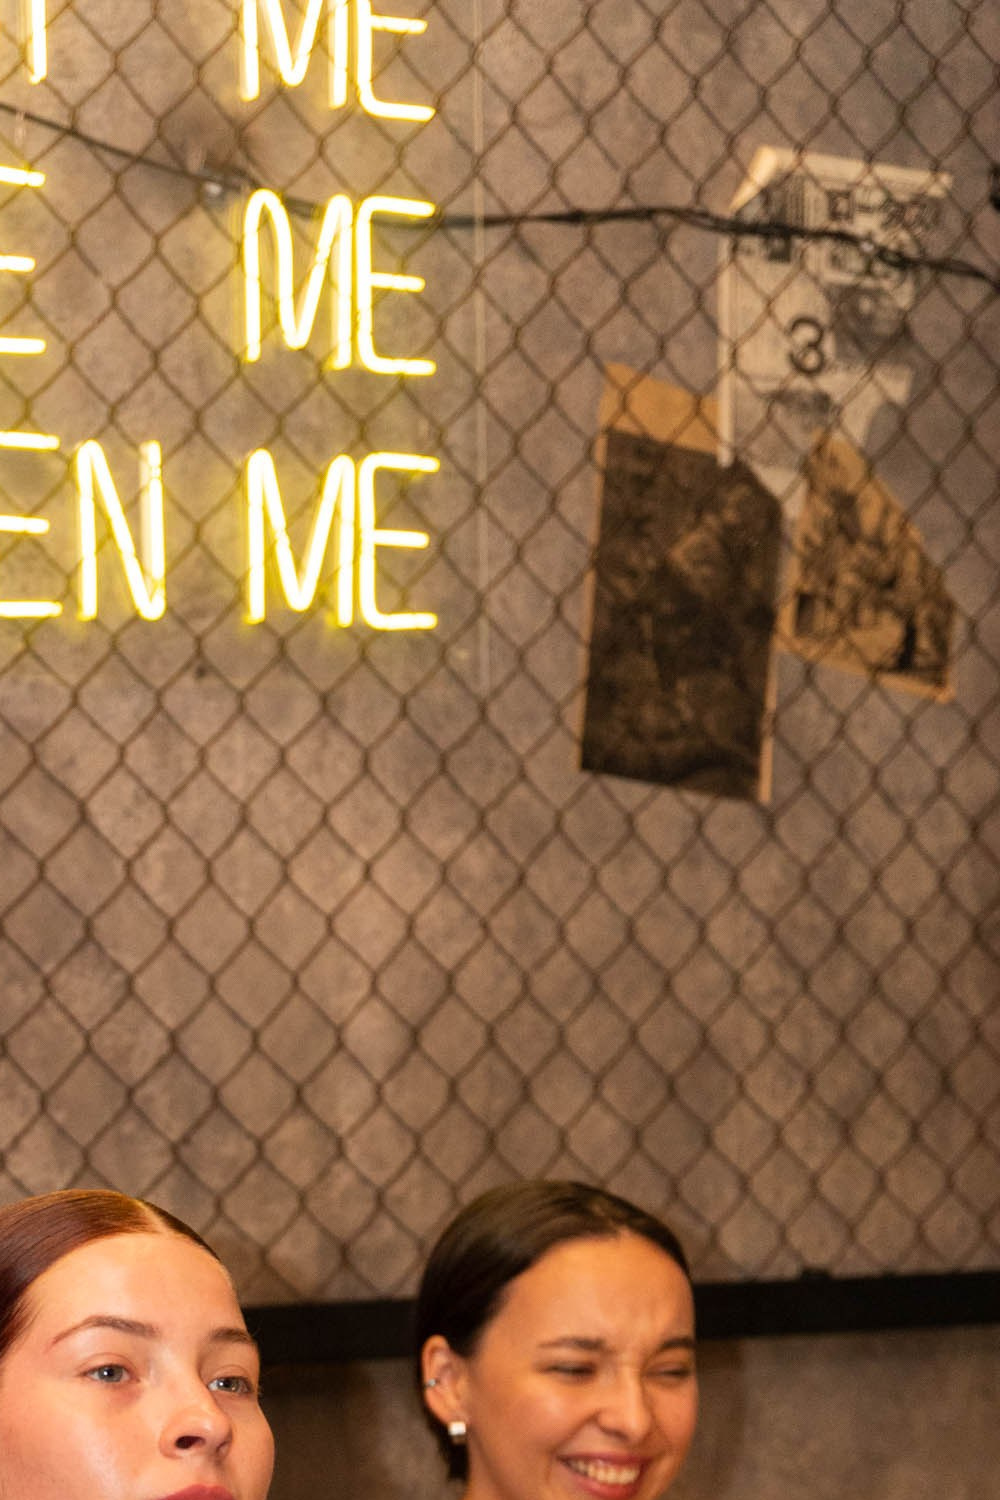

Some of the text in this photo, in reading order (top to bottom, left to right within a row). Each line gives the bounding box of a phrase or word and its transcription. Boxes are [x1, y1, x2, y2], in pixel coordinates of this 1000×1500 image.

[242, 0, 436, 121] ME
[243, 189, 436, 375] ME
[247, 449, 439, 630] ME
